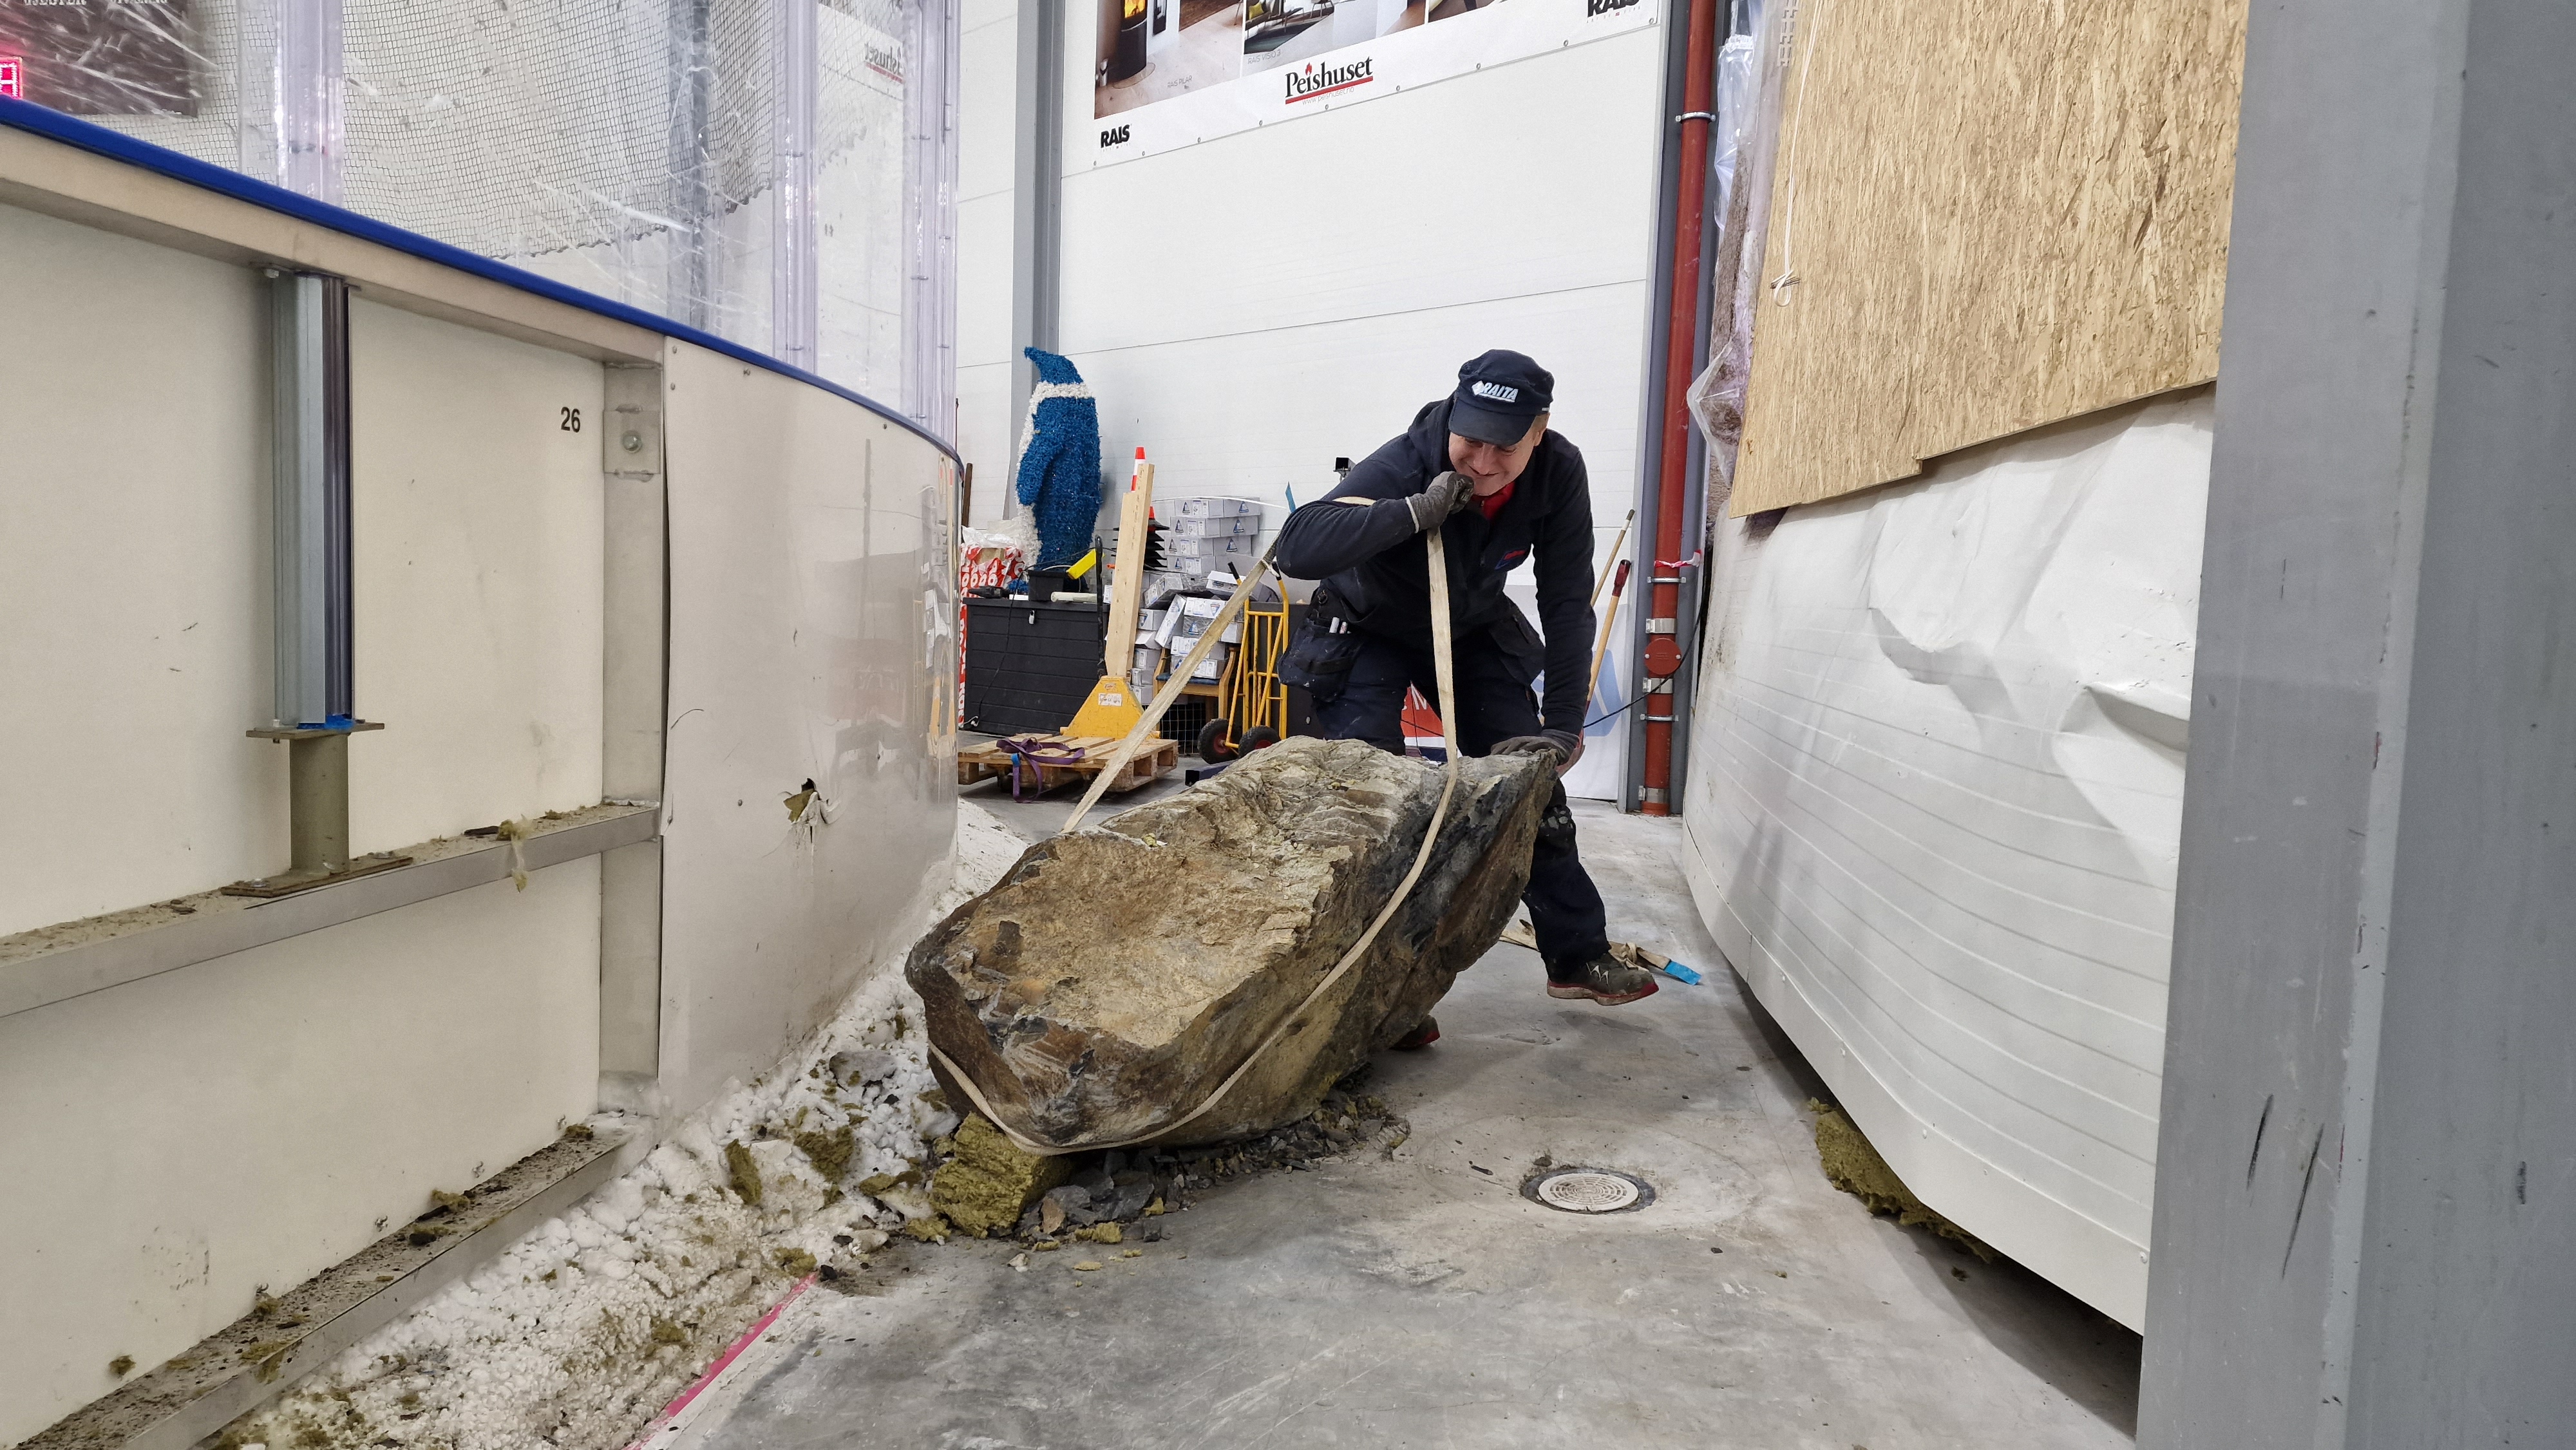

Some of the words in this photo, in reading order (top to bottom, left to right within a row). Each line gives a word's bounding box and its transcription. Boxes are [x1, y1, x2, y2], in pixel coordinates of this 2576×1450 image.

[1587, 0, 1640, 18] RA
[1285, 56, 1373, 98] Peishuset
[1101, 124, 1130, 149] RAIS
[1482, 382, 1519, 400] RAITA
[560, 406, 581, 433] 26
